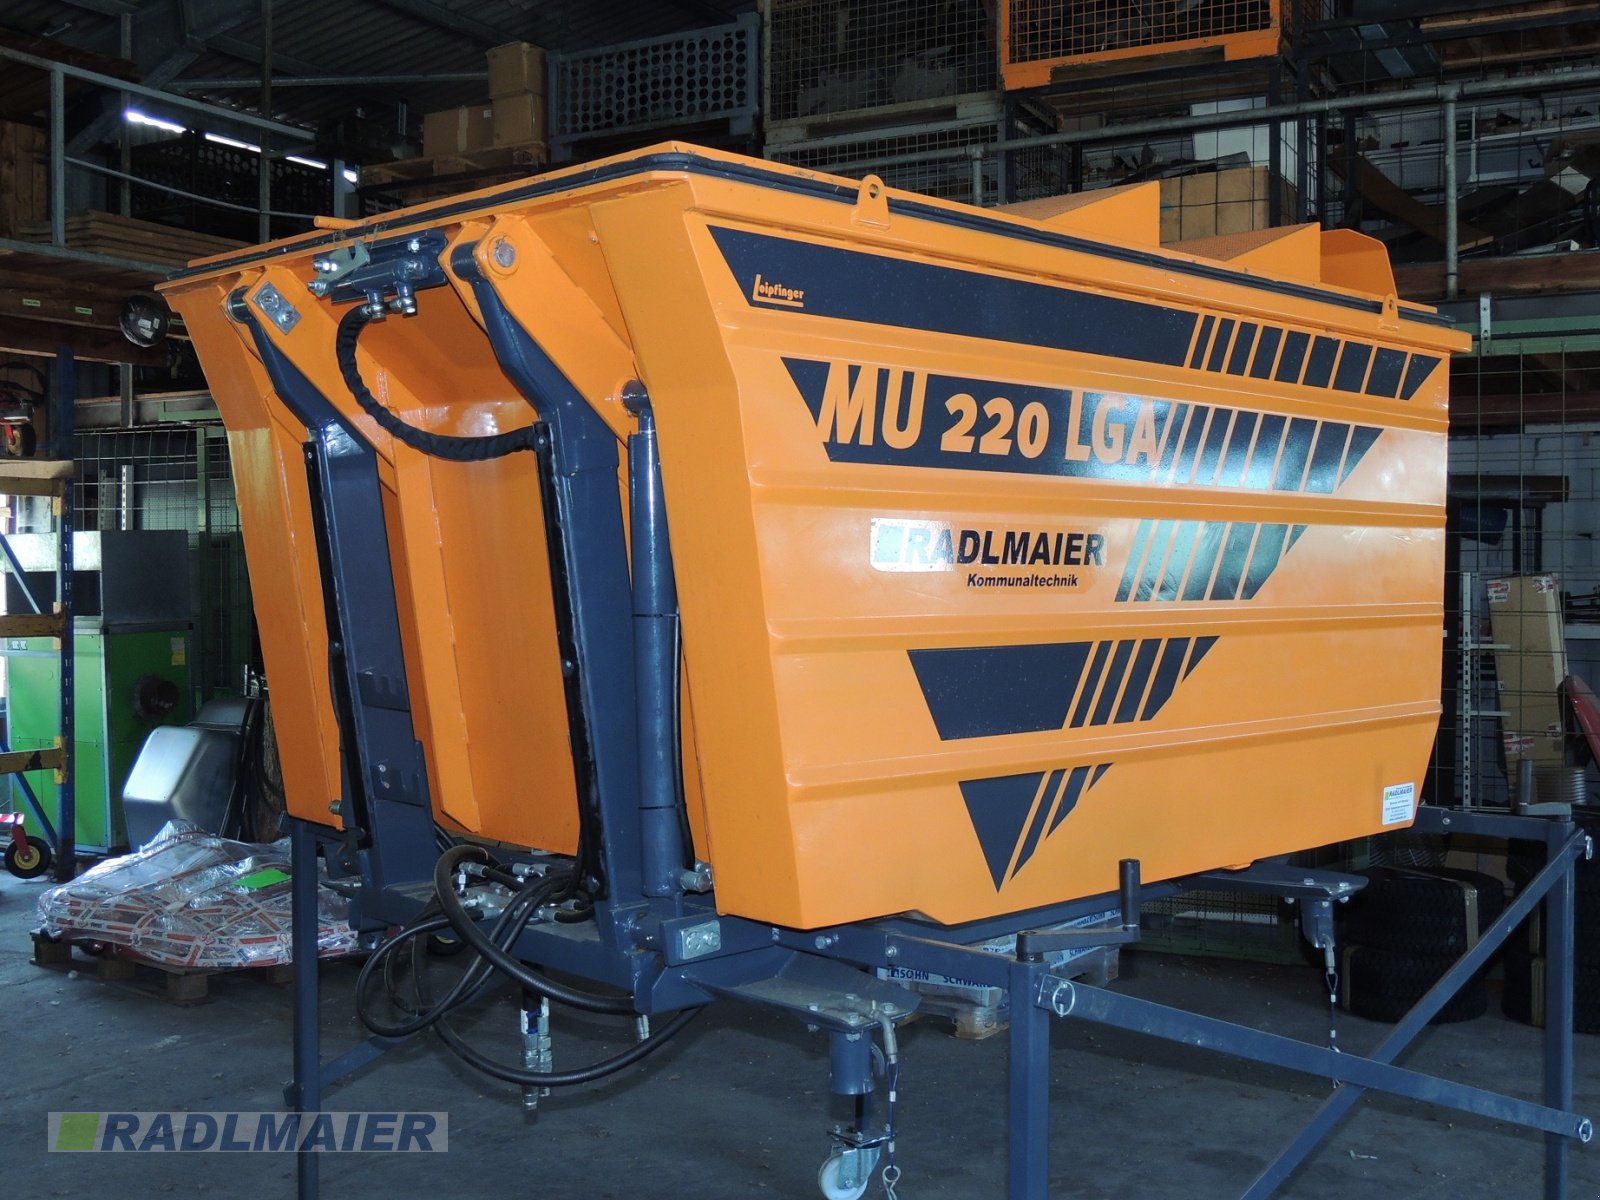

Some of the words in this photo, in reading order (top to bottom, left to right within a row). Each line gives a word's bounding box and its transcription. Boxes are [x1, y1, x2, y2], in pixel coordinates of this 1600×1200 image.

[753, 274, 804, 307] Loipfinger
[817, 362, 928, 450] MU
[940, 393, 1049, 459] 220
[1065, 390, 1161, 465] LGA
[903, 526, 1105, 566] RADLMAIER
[966, 572, 1079, 588] Kommunaltechnik
